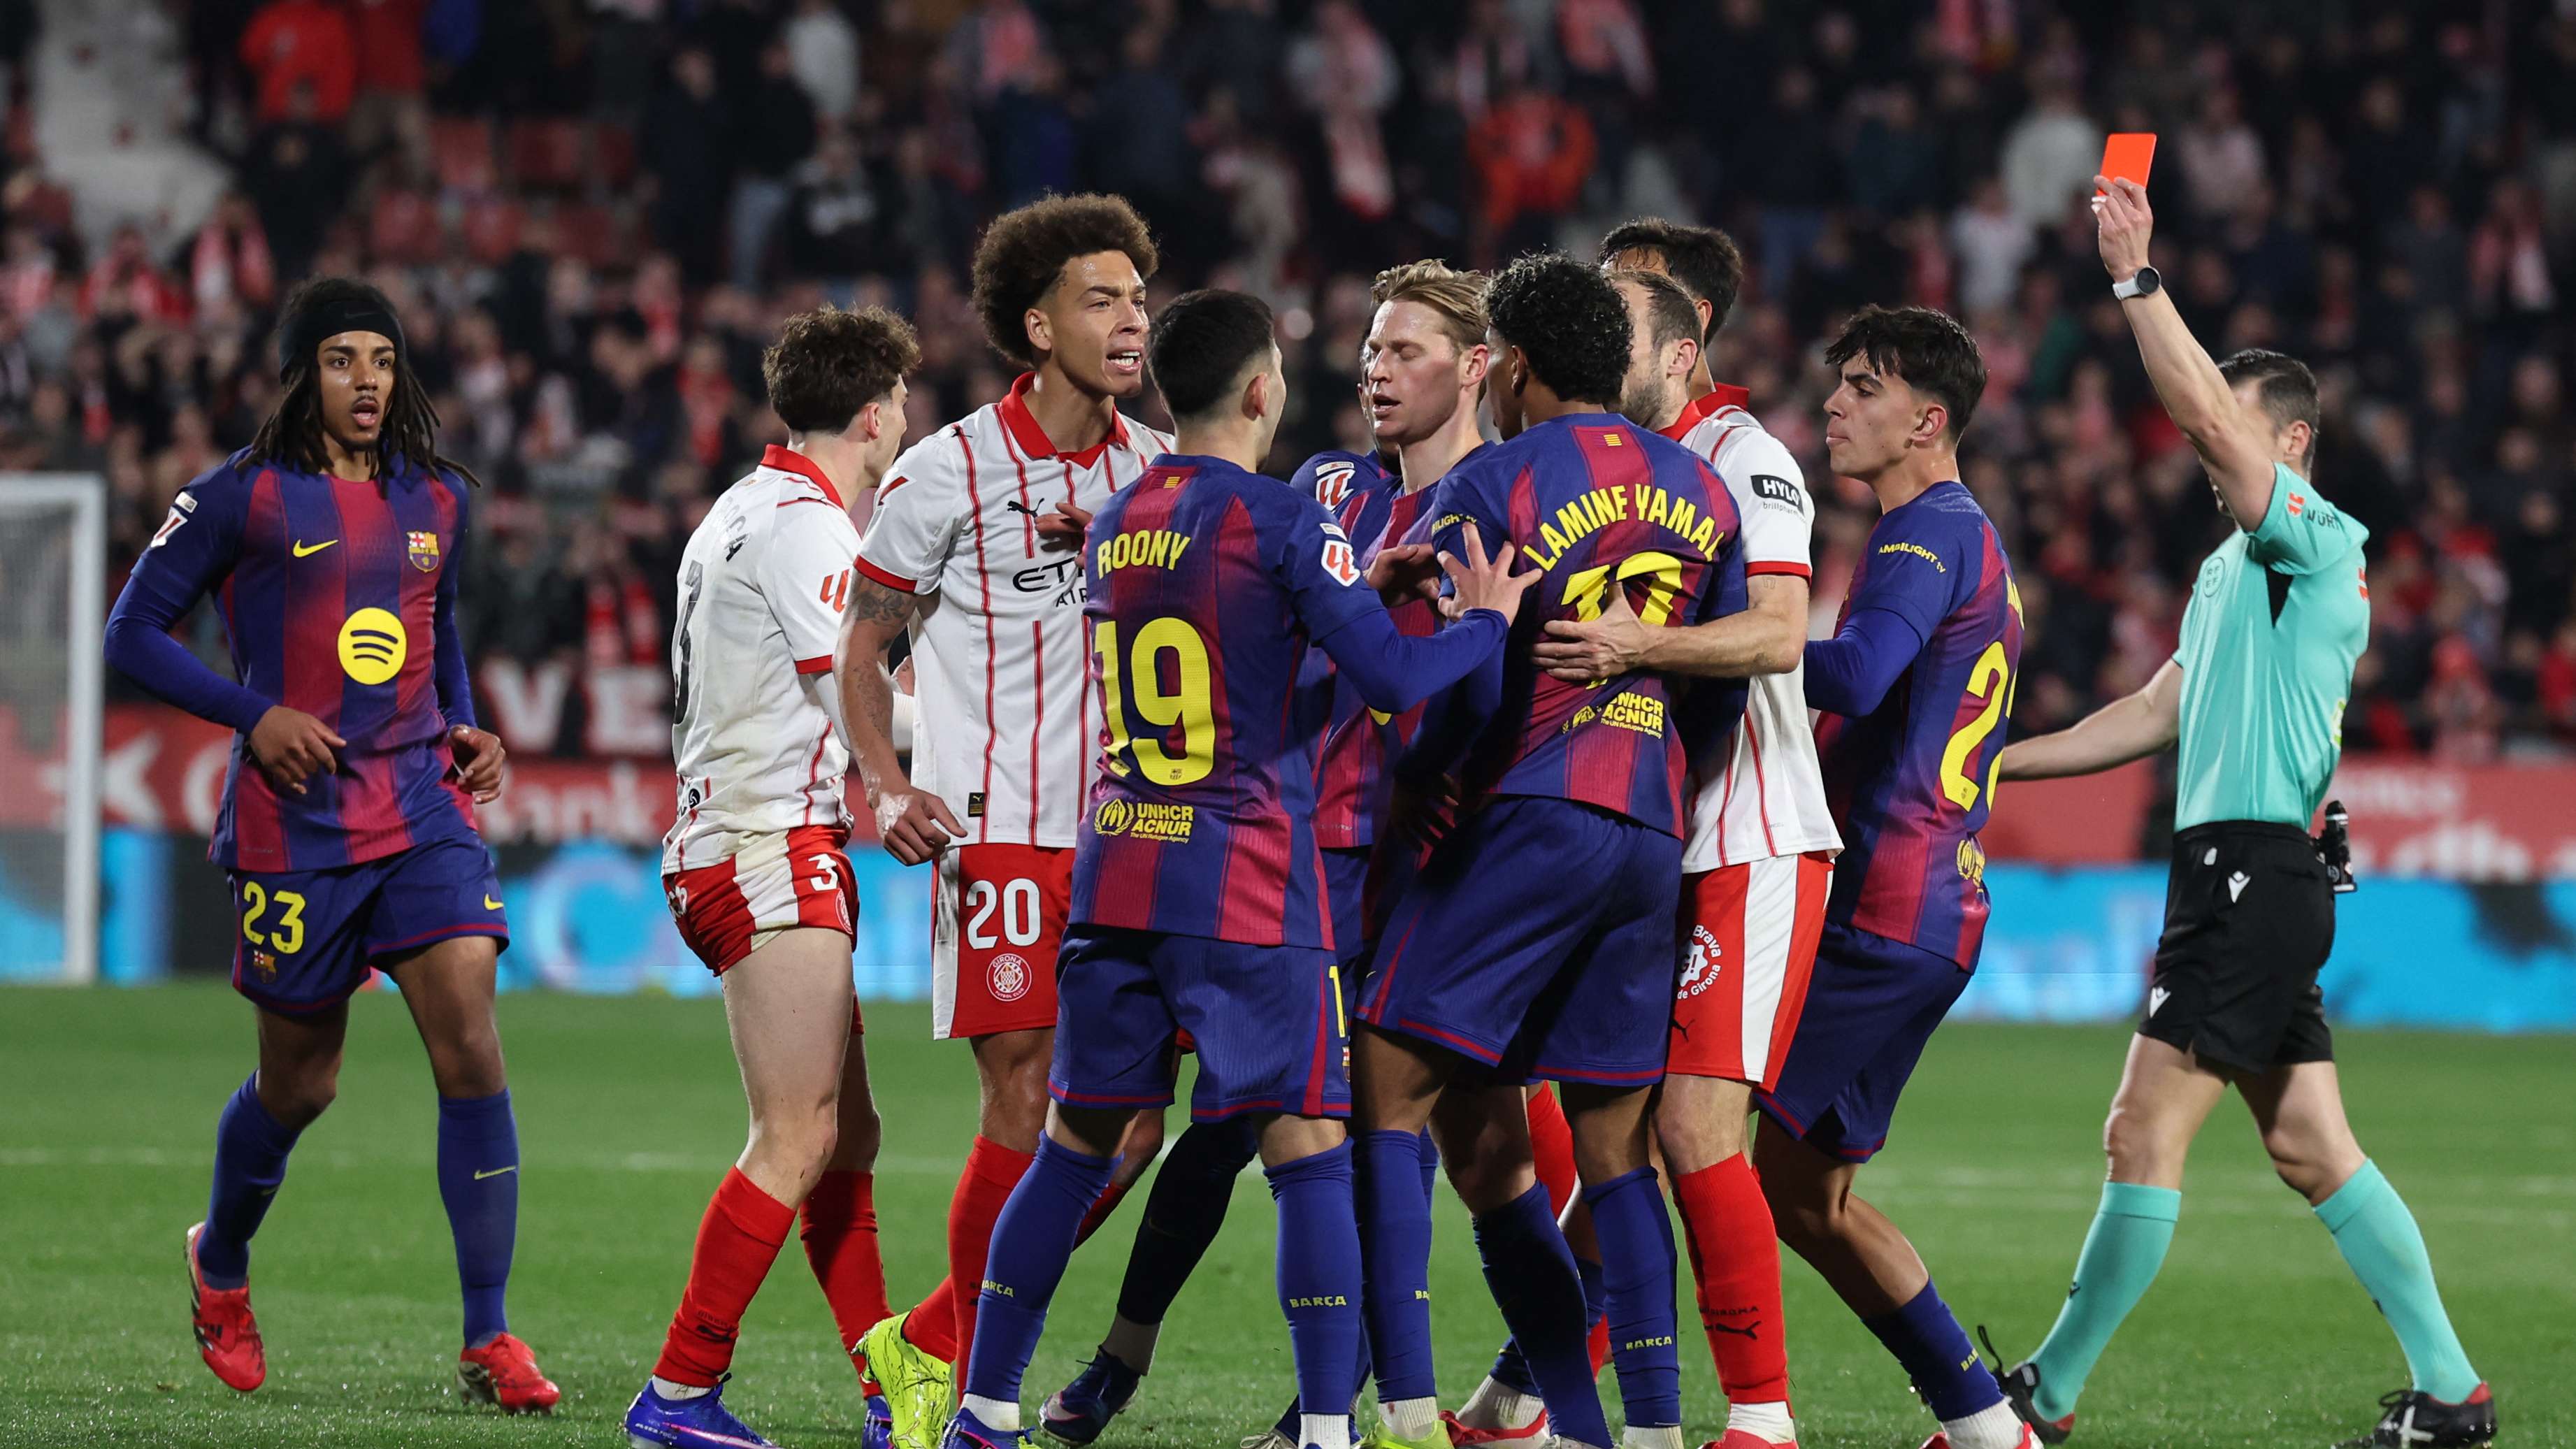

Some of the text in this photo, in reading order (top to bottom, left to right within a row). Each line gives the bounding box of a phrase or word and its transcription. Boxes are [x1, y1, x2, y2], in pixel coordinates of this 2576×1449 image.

[1762, 479, 1800, 505] HYLO
[1522, 483, 1725, 572] LAMINE YAMAL
[1097, 530, 1190, 580] ROONY
[1877, 542, 1938, 563] AMBILIGHT
[1095, 617, 1216, 786] 19
[1602, 704, 1663, 732] ACNUR
[1610, 691, 1664, 717] NHCR
[1131, 819, 1193, 836] ACNUR
[1137, 803, 1194, 821] UNHCR
[808, 853, 839, 891] 3
[243, 881, 306, 954] 23
[965, 878, 1042, 950] 20
[1692, 924, 1722, 958] Brava
[993, 955, 1022, 968] GIRONA
[1677, 965, 1721, 1000] de Girona
